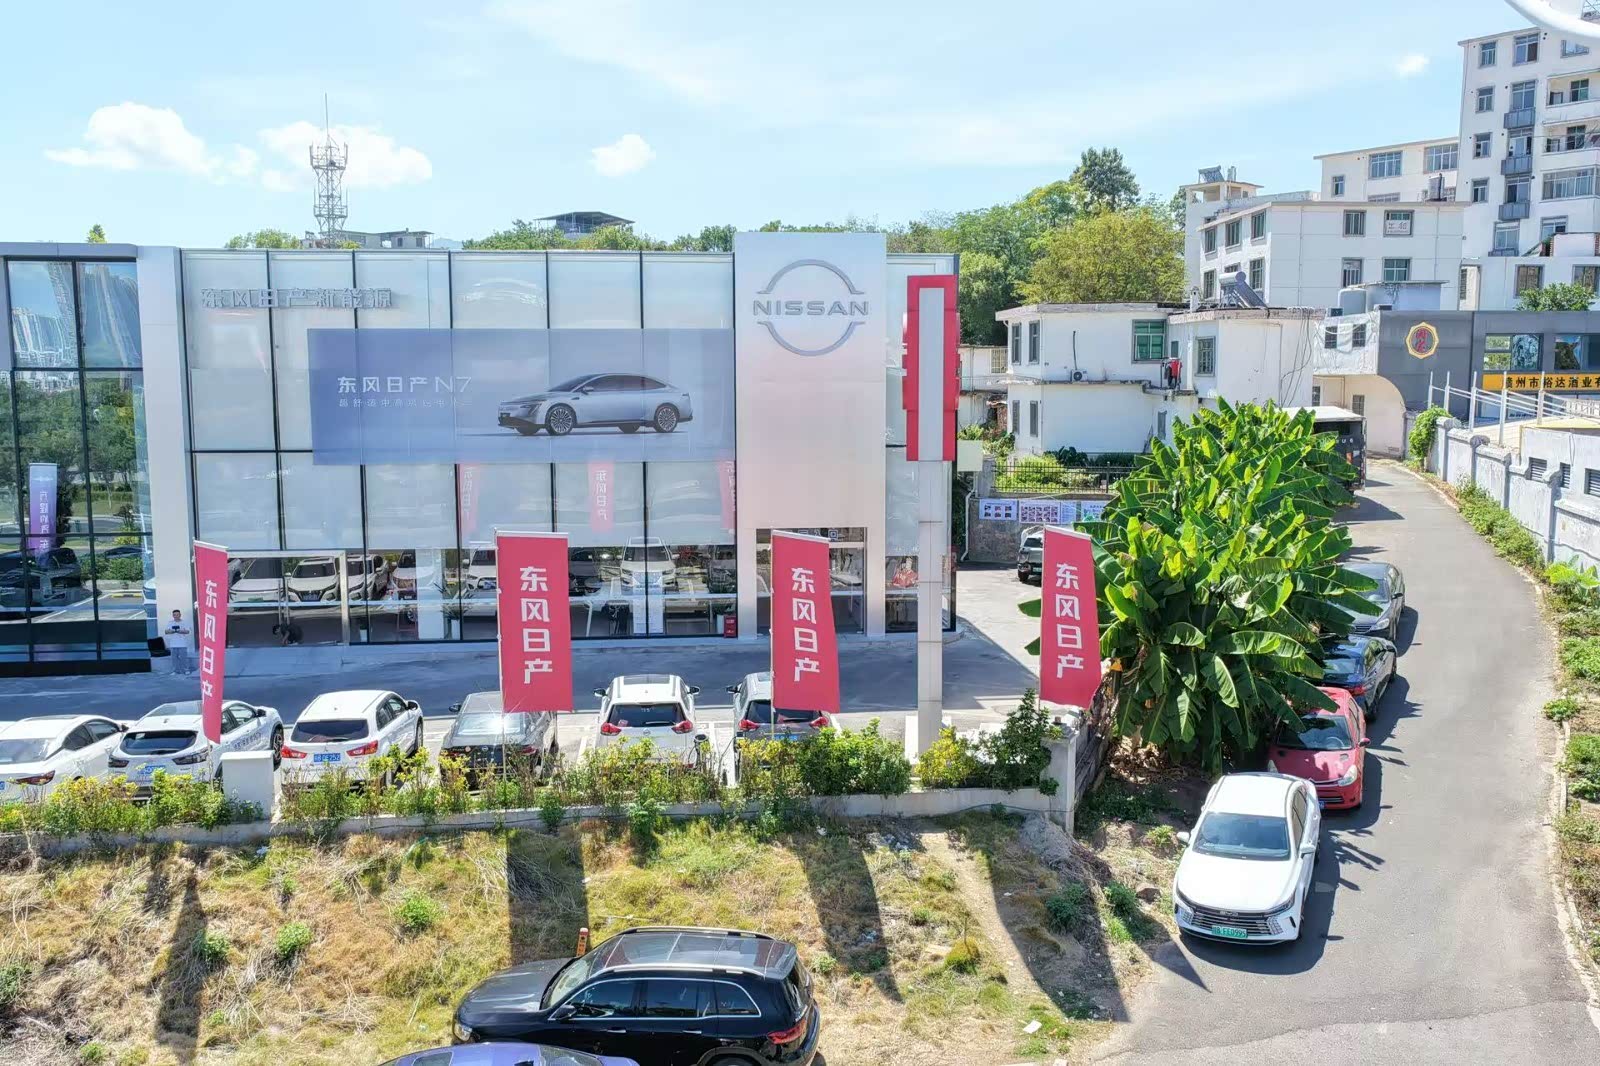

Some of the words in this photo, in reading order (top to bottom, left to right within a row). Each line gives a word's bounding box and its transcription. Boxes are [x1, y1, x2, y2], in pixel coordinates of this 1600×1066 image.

[200, 287, 392, 308] 东风日产新能源
[753, 300, 869, 316] NISSAN
[202, 579, 218, 704] 东风日产
[520, 566, 553, 684] 东风日产
[791, 567, 820, 682] 东风日产
[1055, 563, 1084, 678] 东风日产
